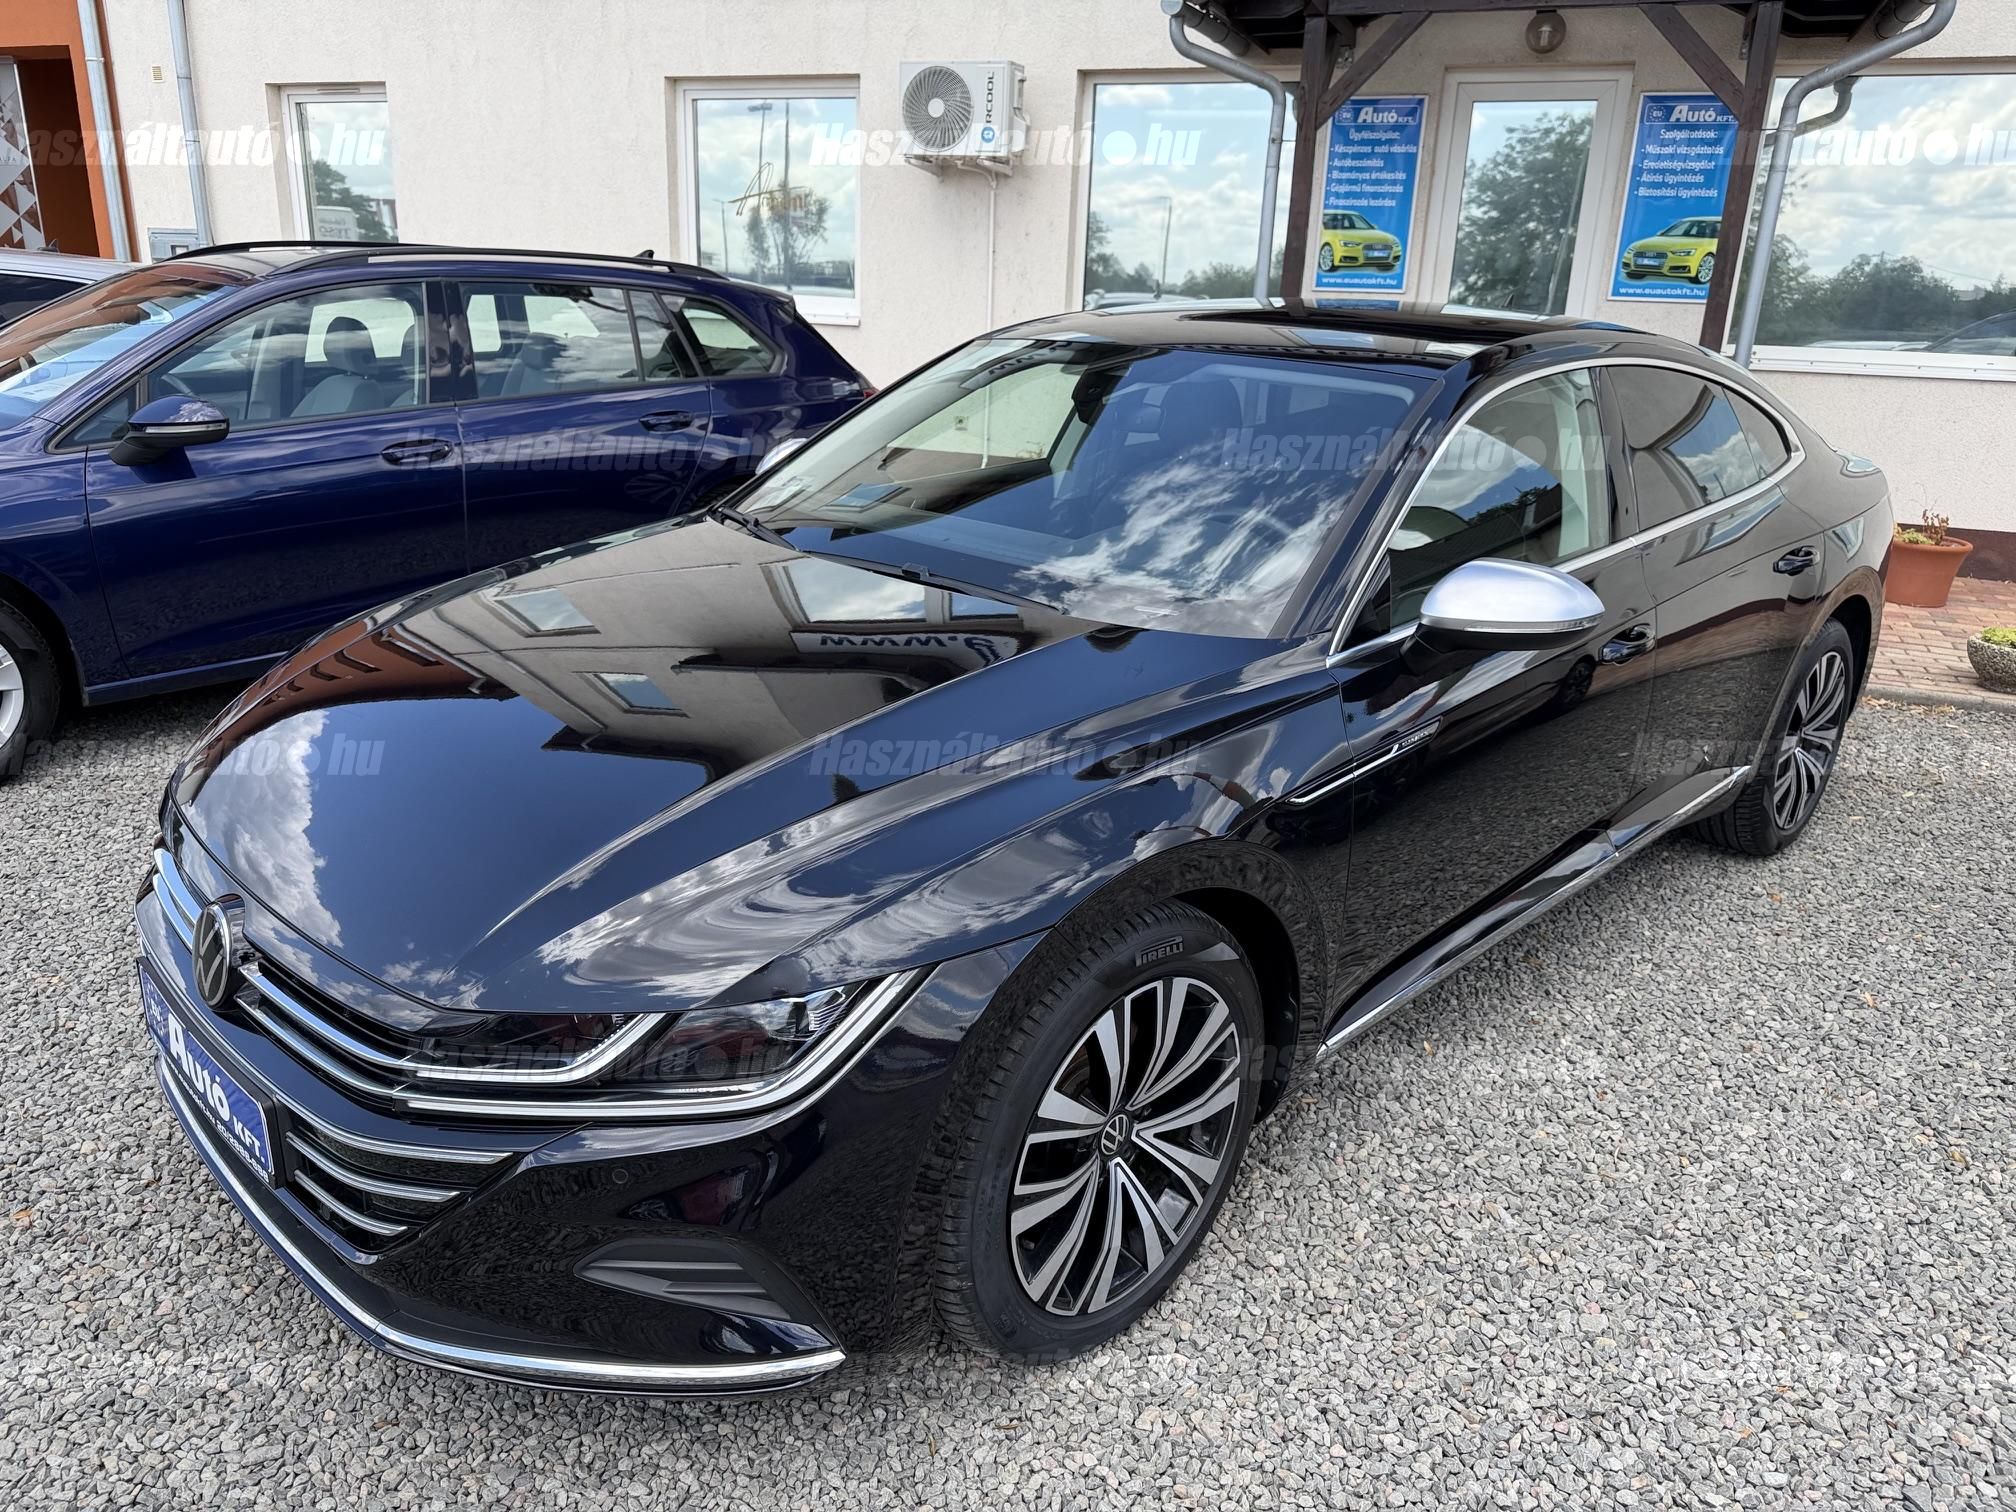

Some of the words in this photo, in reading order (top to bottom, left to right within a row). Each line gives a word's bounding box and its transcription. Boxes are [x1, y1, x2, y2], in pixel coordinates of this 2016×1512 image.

[1357, 107, 1397, 123] Autó
[1669, 105, 1716, 122] Autó
[1660, 129, 1718, 141] Szolgáltatások:
[1321, 277, 1397, 285] www.euautokft.hu
[1619, 287, 1706, 296] www.euautokft.hu
[1135, 935, 1184, 967] PIRELLI
[168, 1011, 231, 1122] Autó
[232, 1114, 266, 1165] KFT.
